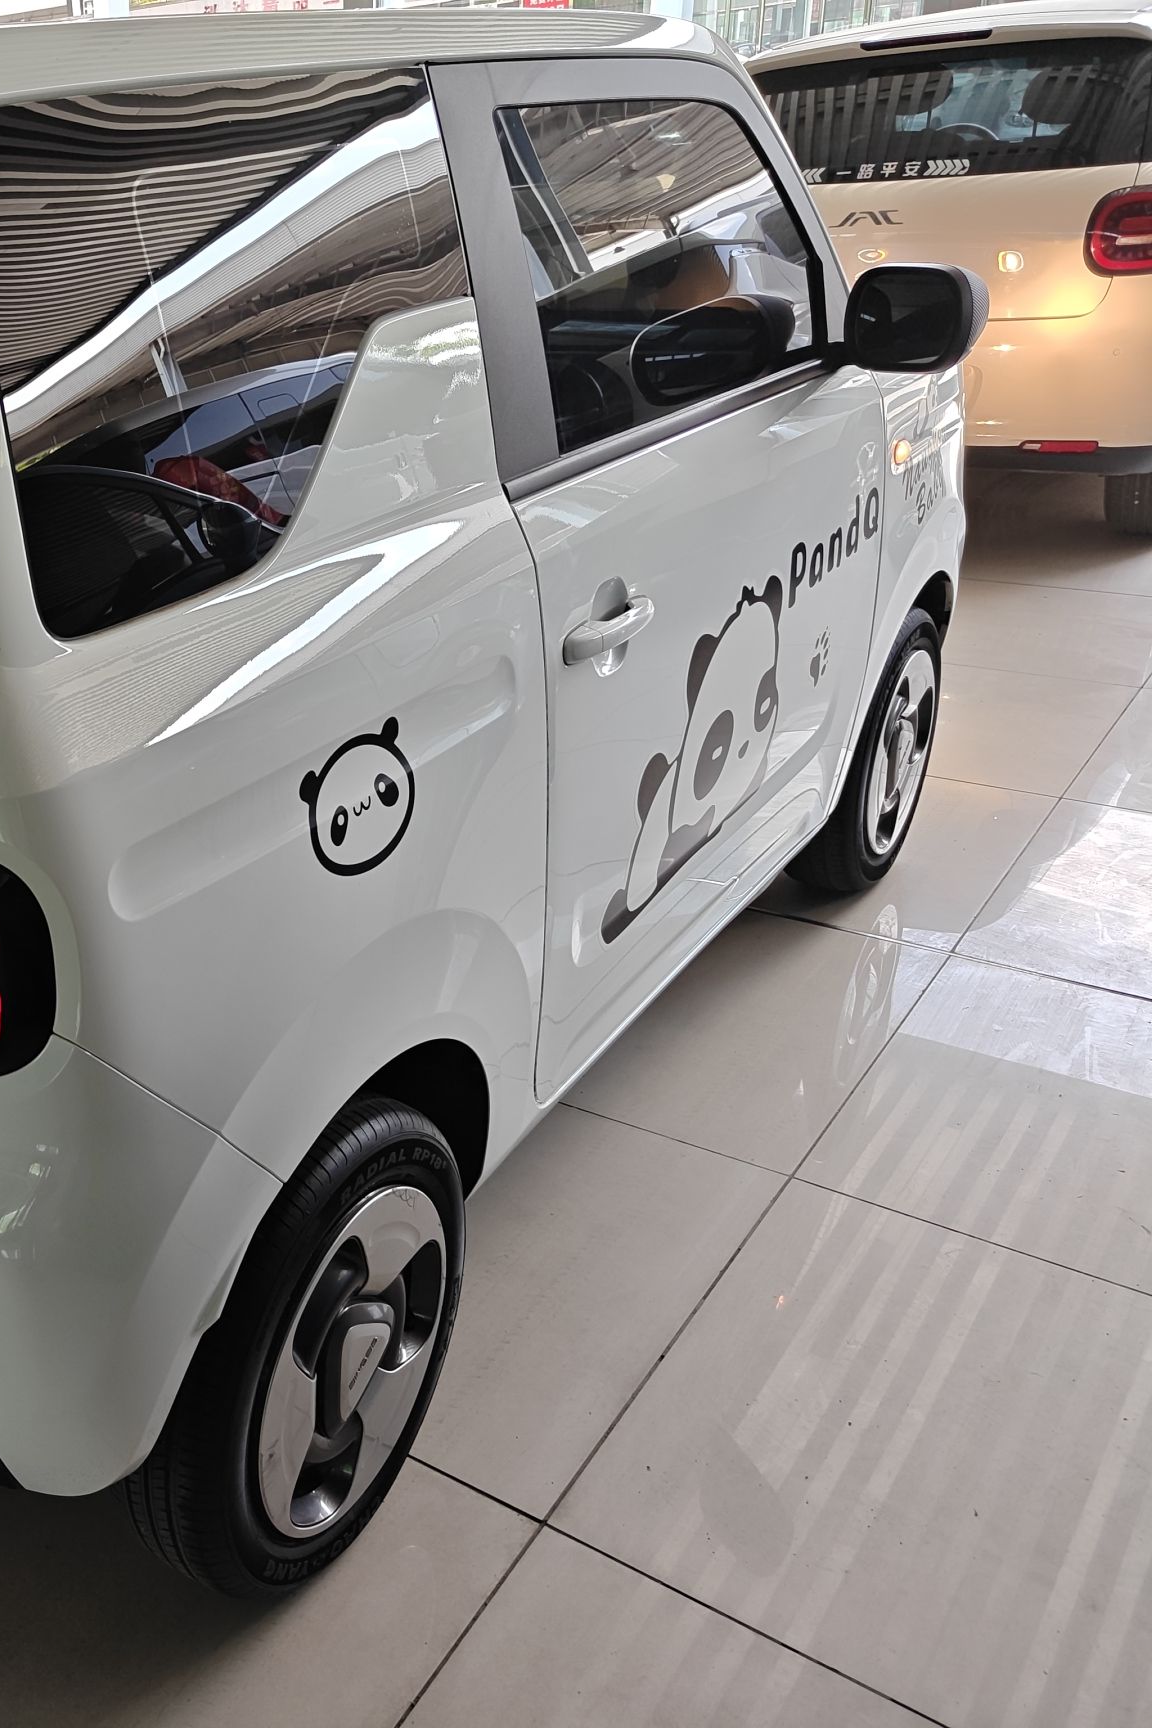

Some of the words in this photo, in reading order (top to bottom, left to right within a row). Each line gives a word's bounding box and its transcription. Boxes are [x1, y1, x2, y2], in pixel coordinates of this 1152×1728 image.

[835, 160, 922, 181] 一路平安
[828, 209, 904, 228] JAC
